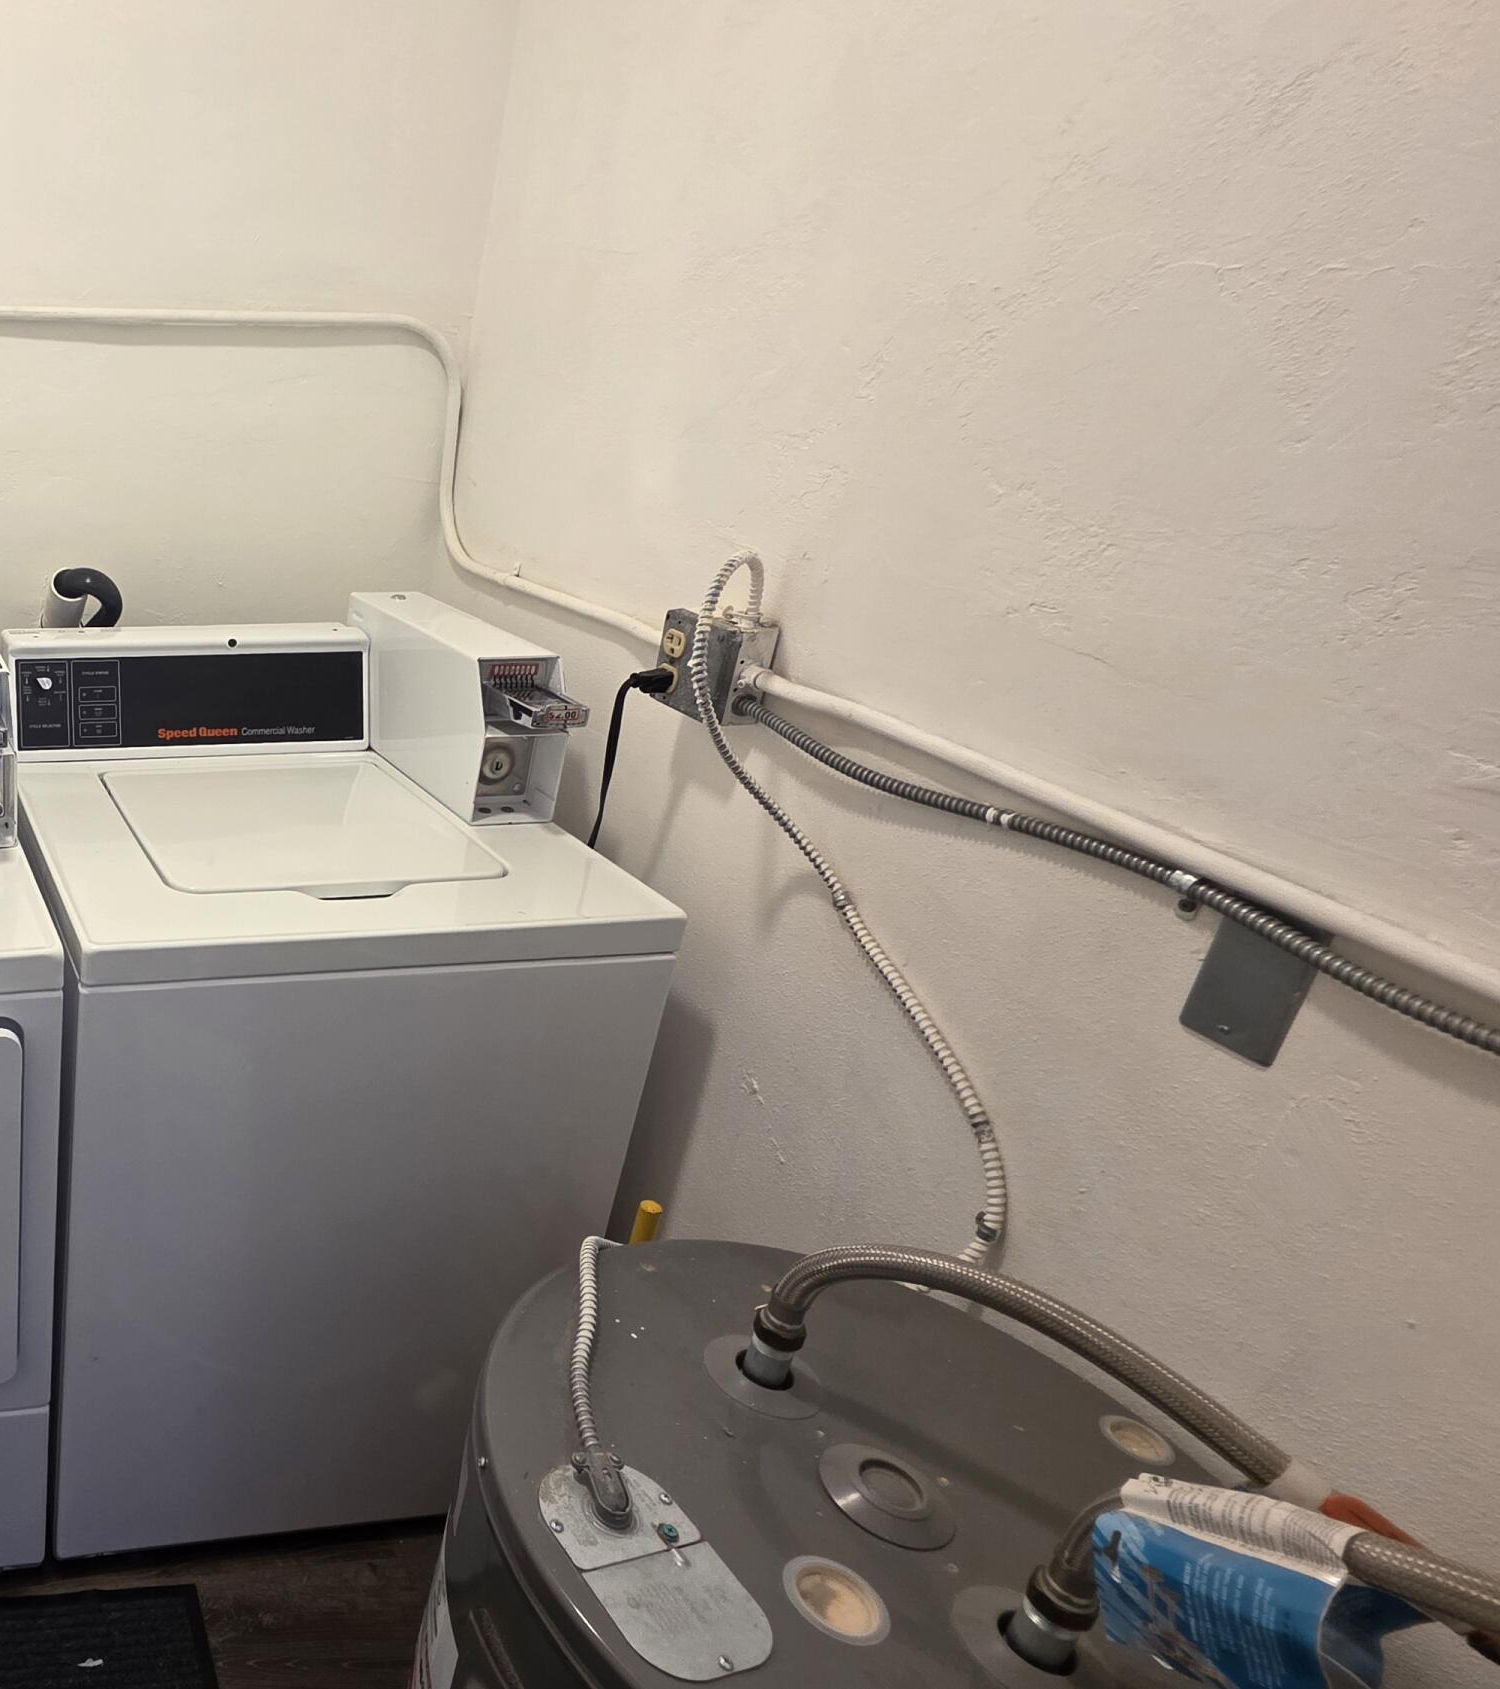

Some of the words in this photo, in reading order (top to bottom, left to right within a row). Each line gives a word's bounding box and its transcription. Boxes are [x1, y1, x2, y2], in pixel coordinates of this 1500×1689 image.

[158, 727, 197, 740] Speed
[199, 726, 238, 737] Queen
[241, 726, 286, 736] Commercial
[287, 726, 315, 735] Washer
